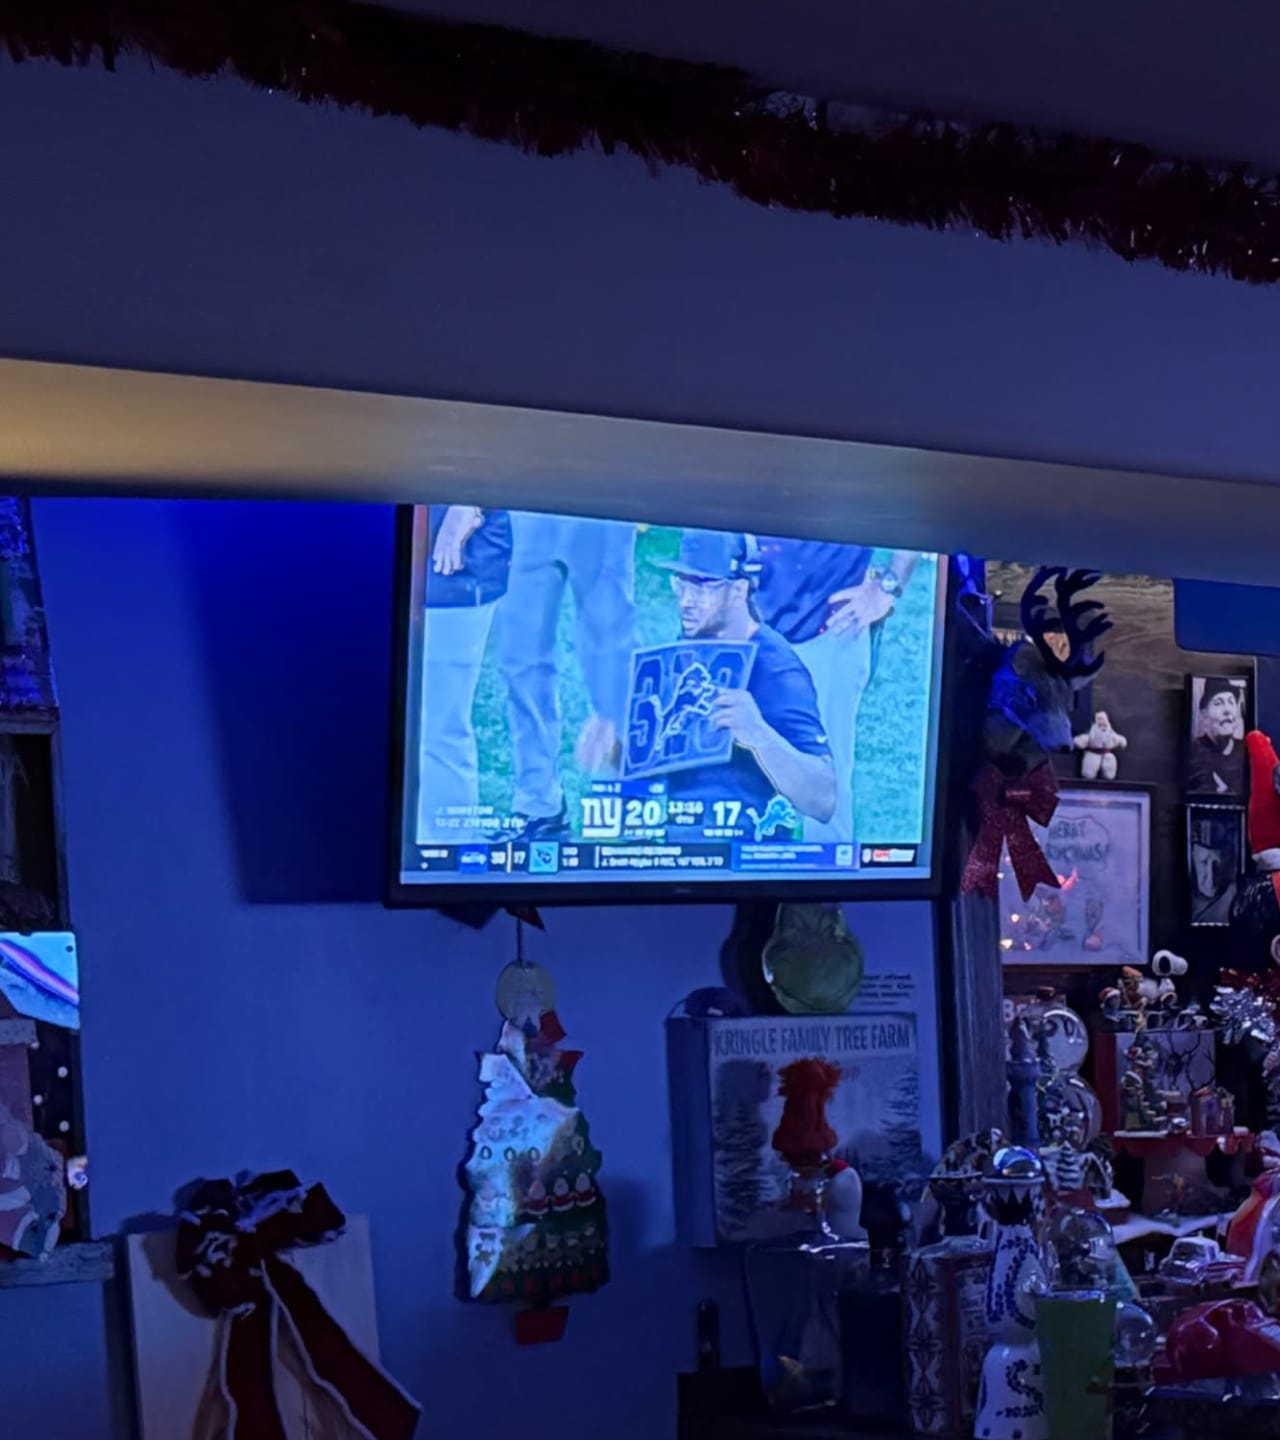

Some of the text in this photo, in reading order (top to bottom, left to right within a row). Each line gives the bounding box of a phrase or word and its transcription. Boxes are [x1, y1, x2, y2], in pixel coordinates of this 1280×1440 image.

[625, 800, 661, 826] 20
[713, 801, 741, 827] 17
[713, 1022, 910, 1056] KRINGLE FAMILY TREE FARM
